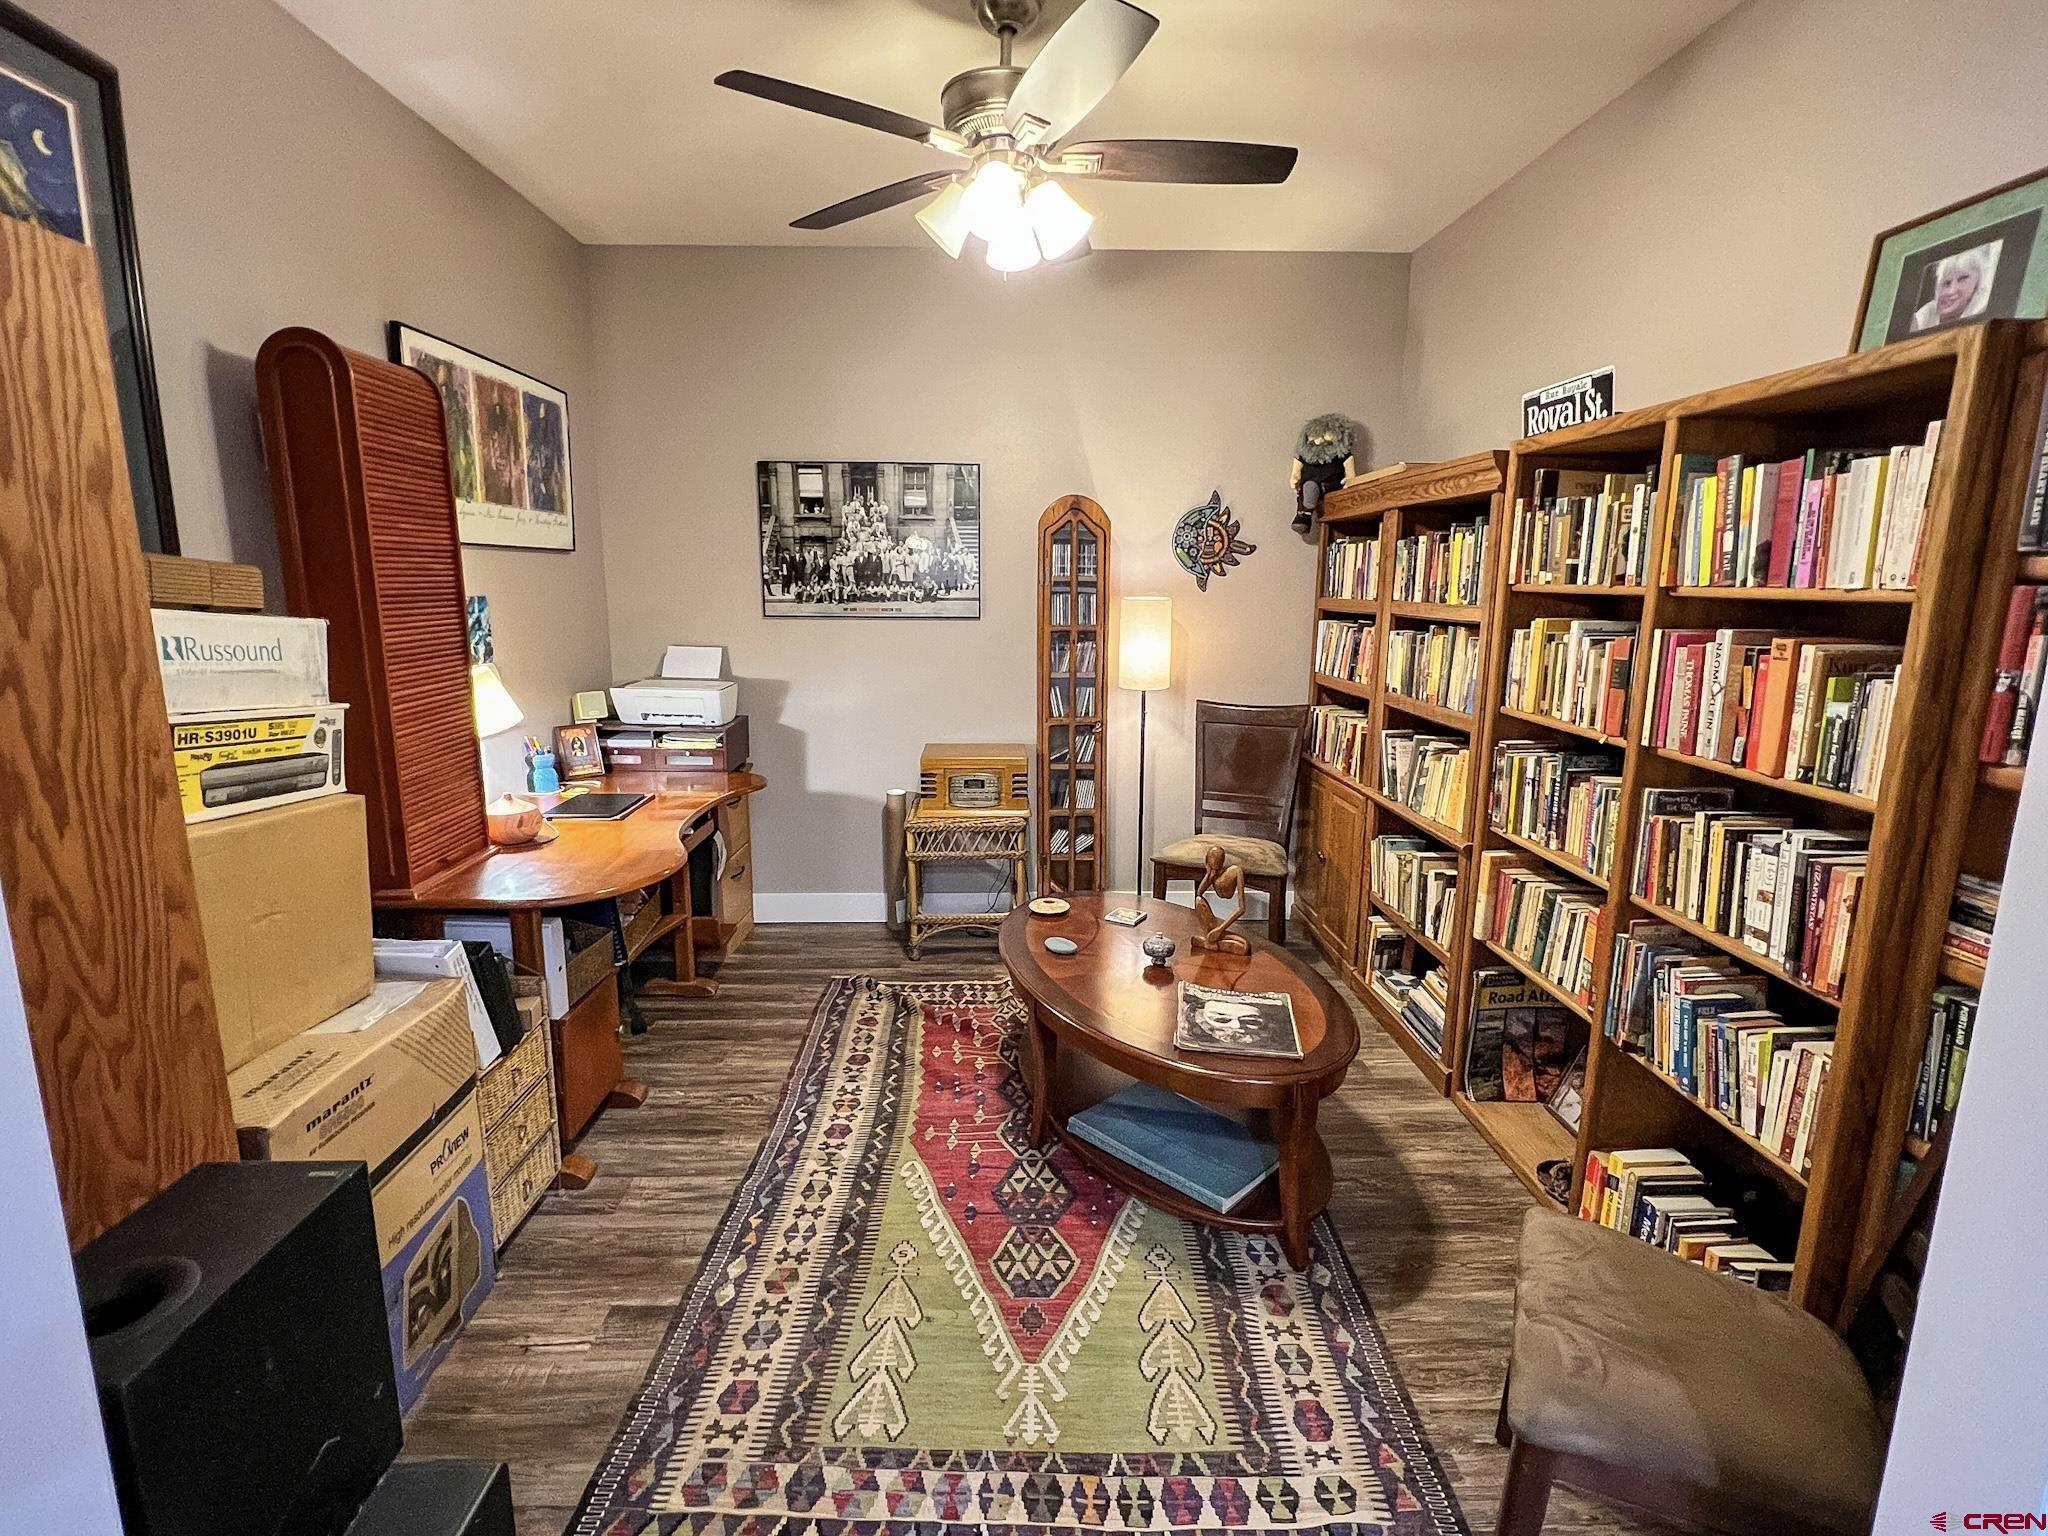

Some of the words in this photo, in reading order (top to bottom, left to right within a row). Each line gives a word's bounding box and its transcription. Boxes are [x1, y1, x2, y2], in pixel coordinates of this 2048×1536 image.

[1526, 392, 1582, 437] Royal
[1584, 388, 1608, 423] St.
[184, 636, 283, 663] Russound
[1683, 659, 1695, 708] THOMAS
[177, 728, 257, 746] HR-S3901U
[1489, 989, 1524, 1004] Road
[1955, 1005, 1969, 1046] PORTLAND
[306, 1073, 375, 1133] marantz
[430, 1126, 469, 1175] PROVIEW
[389, 1226, 406, 1249] High
[406, 1193, 438, 1232] resolution
[1640, 1217, 1652, 1242] Mex
